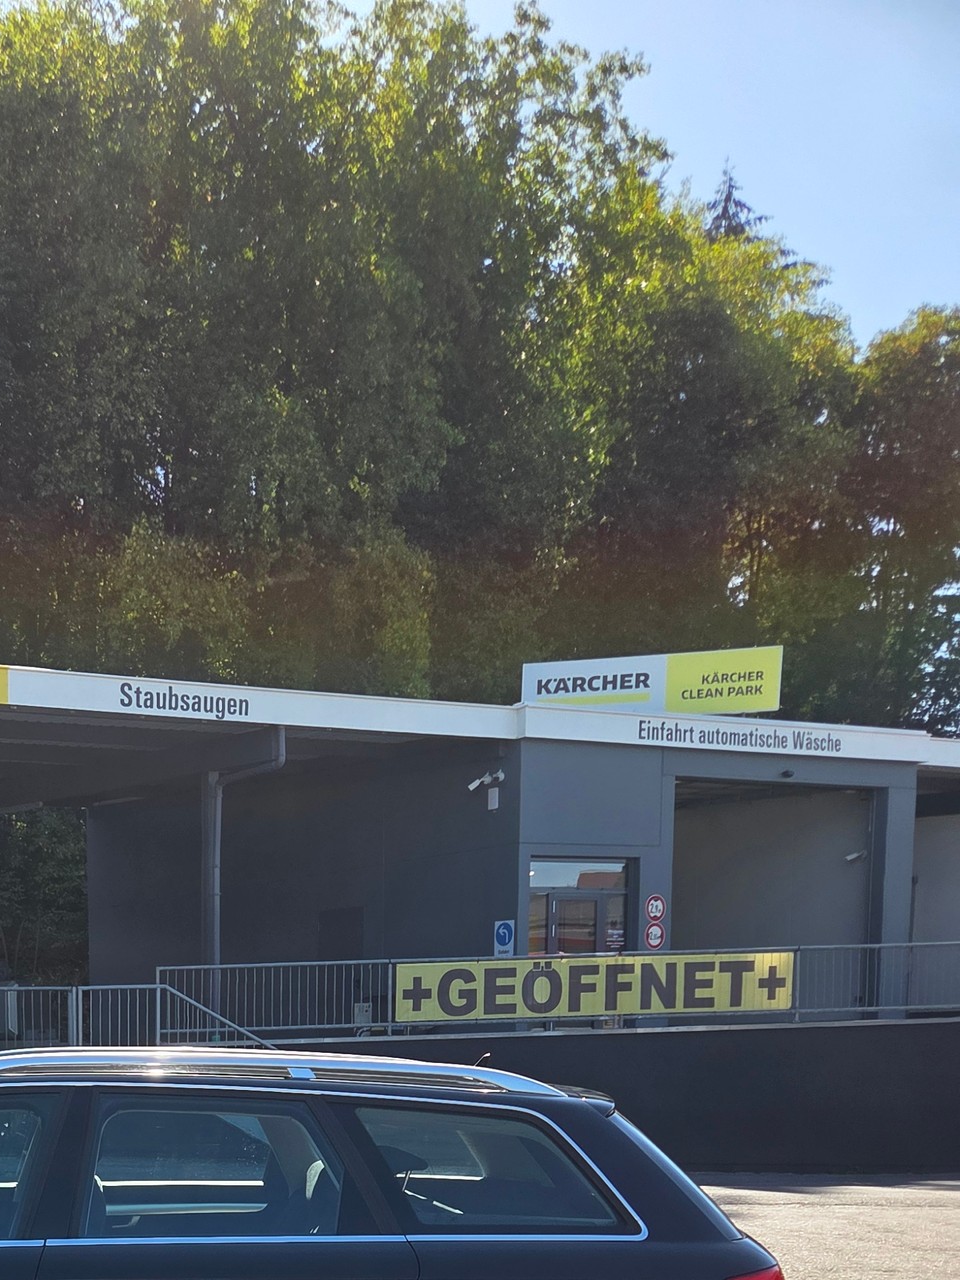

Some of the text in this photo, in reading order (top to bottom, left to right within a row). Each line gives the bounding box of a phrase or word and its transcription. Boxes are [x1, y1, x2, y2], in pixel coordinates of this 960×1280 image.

[536, 672, 650, 695] KÄRCHER
[701, 670, 764, 685] KÄRCHER
[120, 682, 249, 719] Staubsaugen
[681, 684, 763, 700] CLEAN PARK
[638, 720, 842, 752] Einfahrt automatische Wäsche
